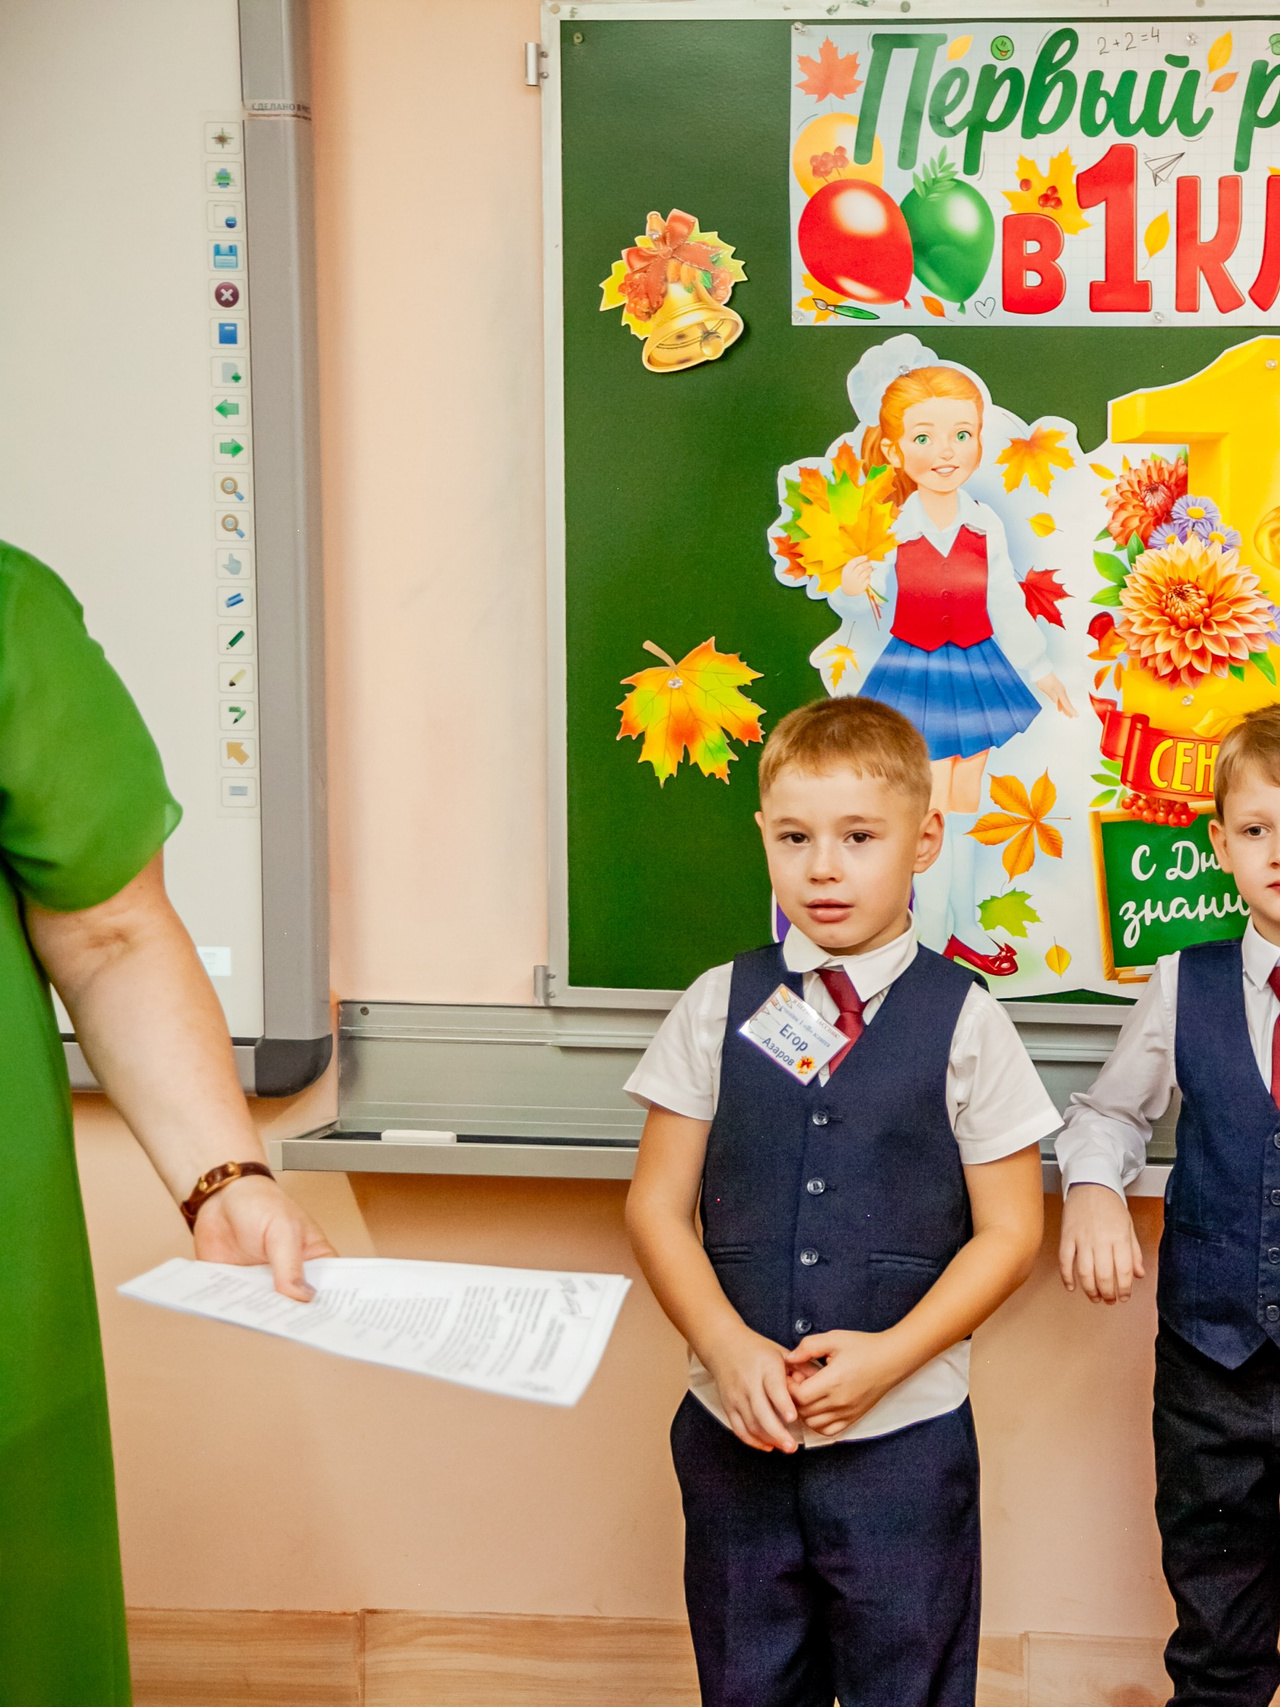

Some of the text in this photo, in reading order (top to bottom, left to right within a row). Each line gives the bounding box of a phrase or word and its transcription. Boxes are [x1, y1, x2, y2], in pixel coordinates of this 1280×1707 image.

[853, 27, 1214, 176] Первый
[1076, 143, 1153, 313] 1
[1131, 844, 1157, 881] С
[762, 1037, 795, 1067] Азаров
[779, 1023, 809, 1052] Егор
